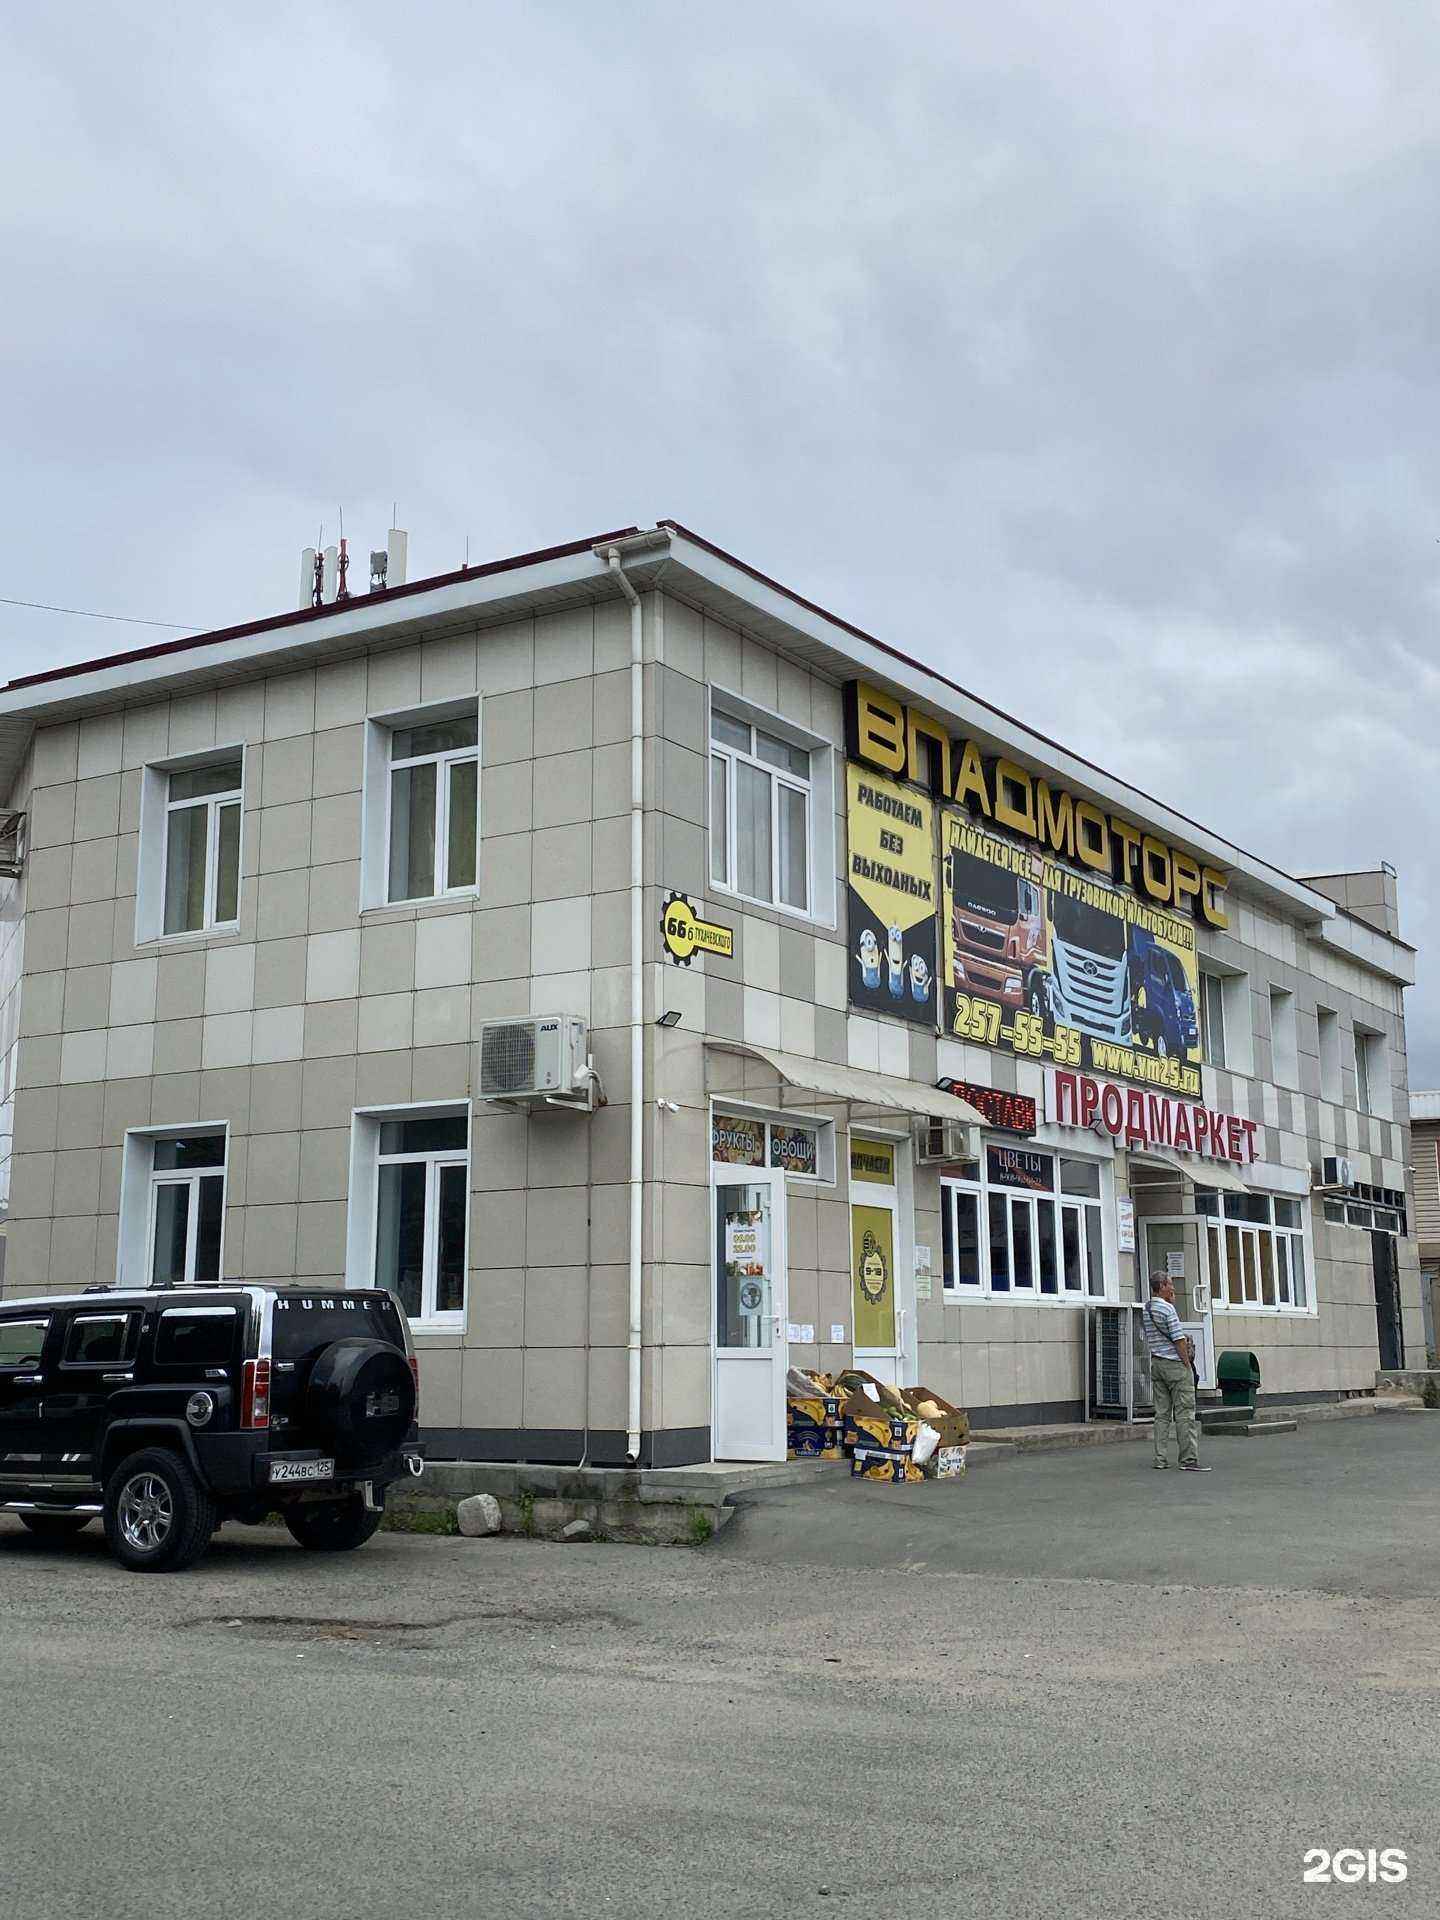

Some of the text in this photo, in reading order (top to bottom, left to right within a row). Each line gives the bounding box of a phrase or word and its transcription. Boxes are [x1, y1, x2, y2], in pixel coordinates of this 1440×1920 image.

[857, 680, 1230, 930] ВЛАДМОТОРС
[858, 783, 923, 829] РАБОТАЕМ
[880, 828, 904, 856] БЕЗ
[852, 854, 932, 901] ВЫХОДНЫХ
[1043, 861, 1062, 893] ДЛЯ
[1064, 872, 1125, 919] ГРУЗОВИКОВ
[541, 1023, 558, 1032] AUX
[953, 991, 1082, 1068] 257-55-55
[1054, 1069, 1258, 1164] ПРОДМАРКЕТ
[772, 1138, 814, 1162] ОВОЩИ
[998, 1149, 1041, 1173] ЦВЕТЫ
[277, 1299, 391, 1311] HUMMER
